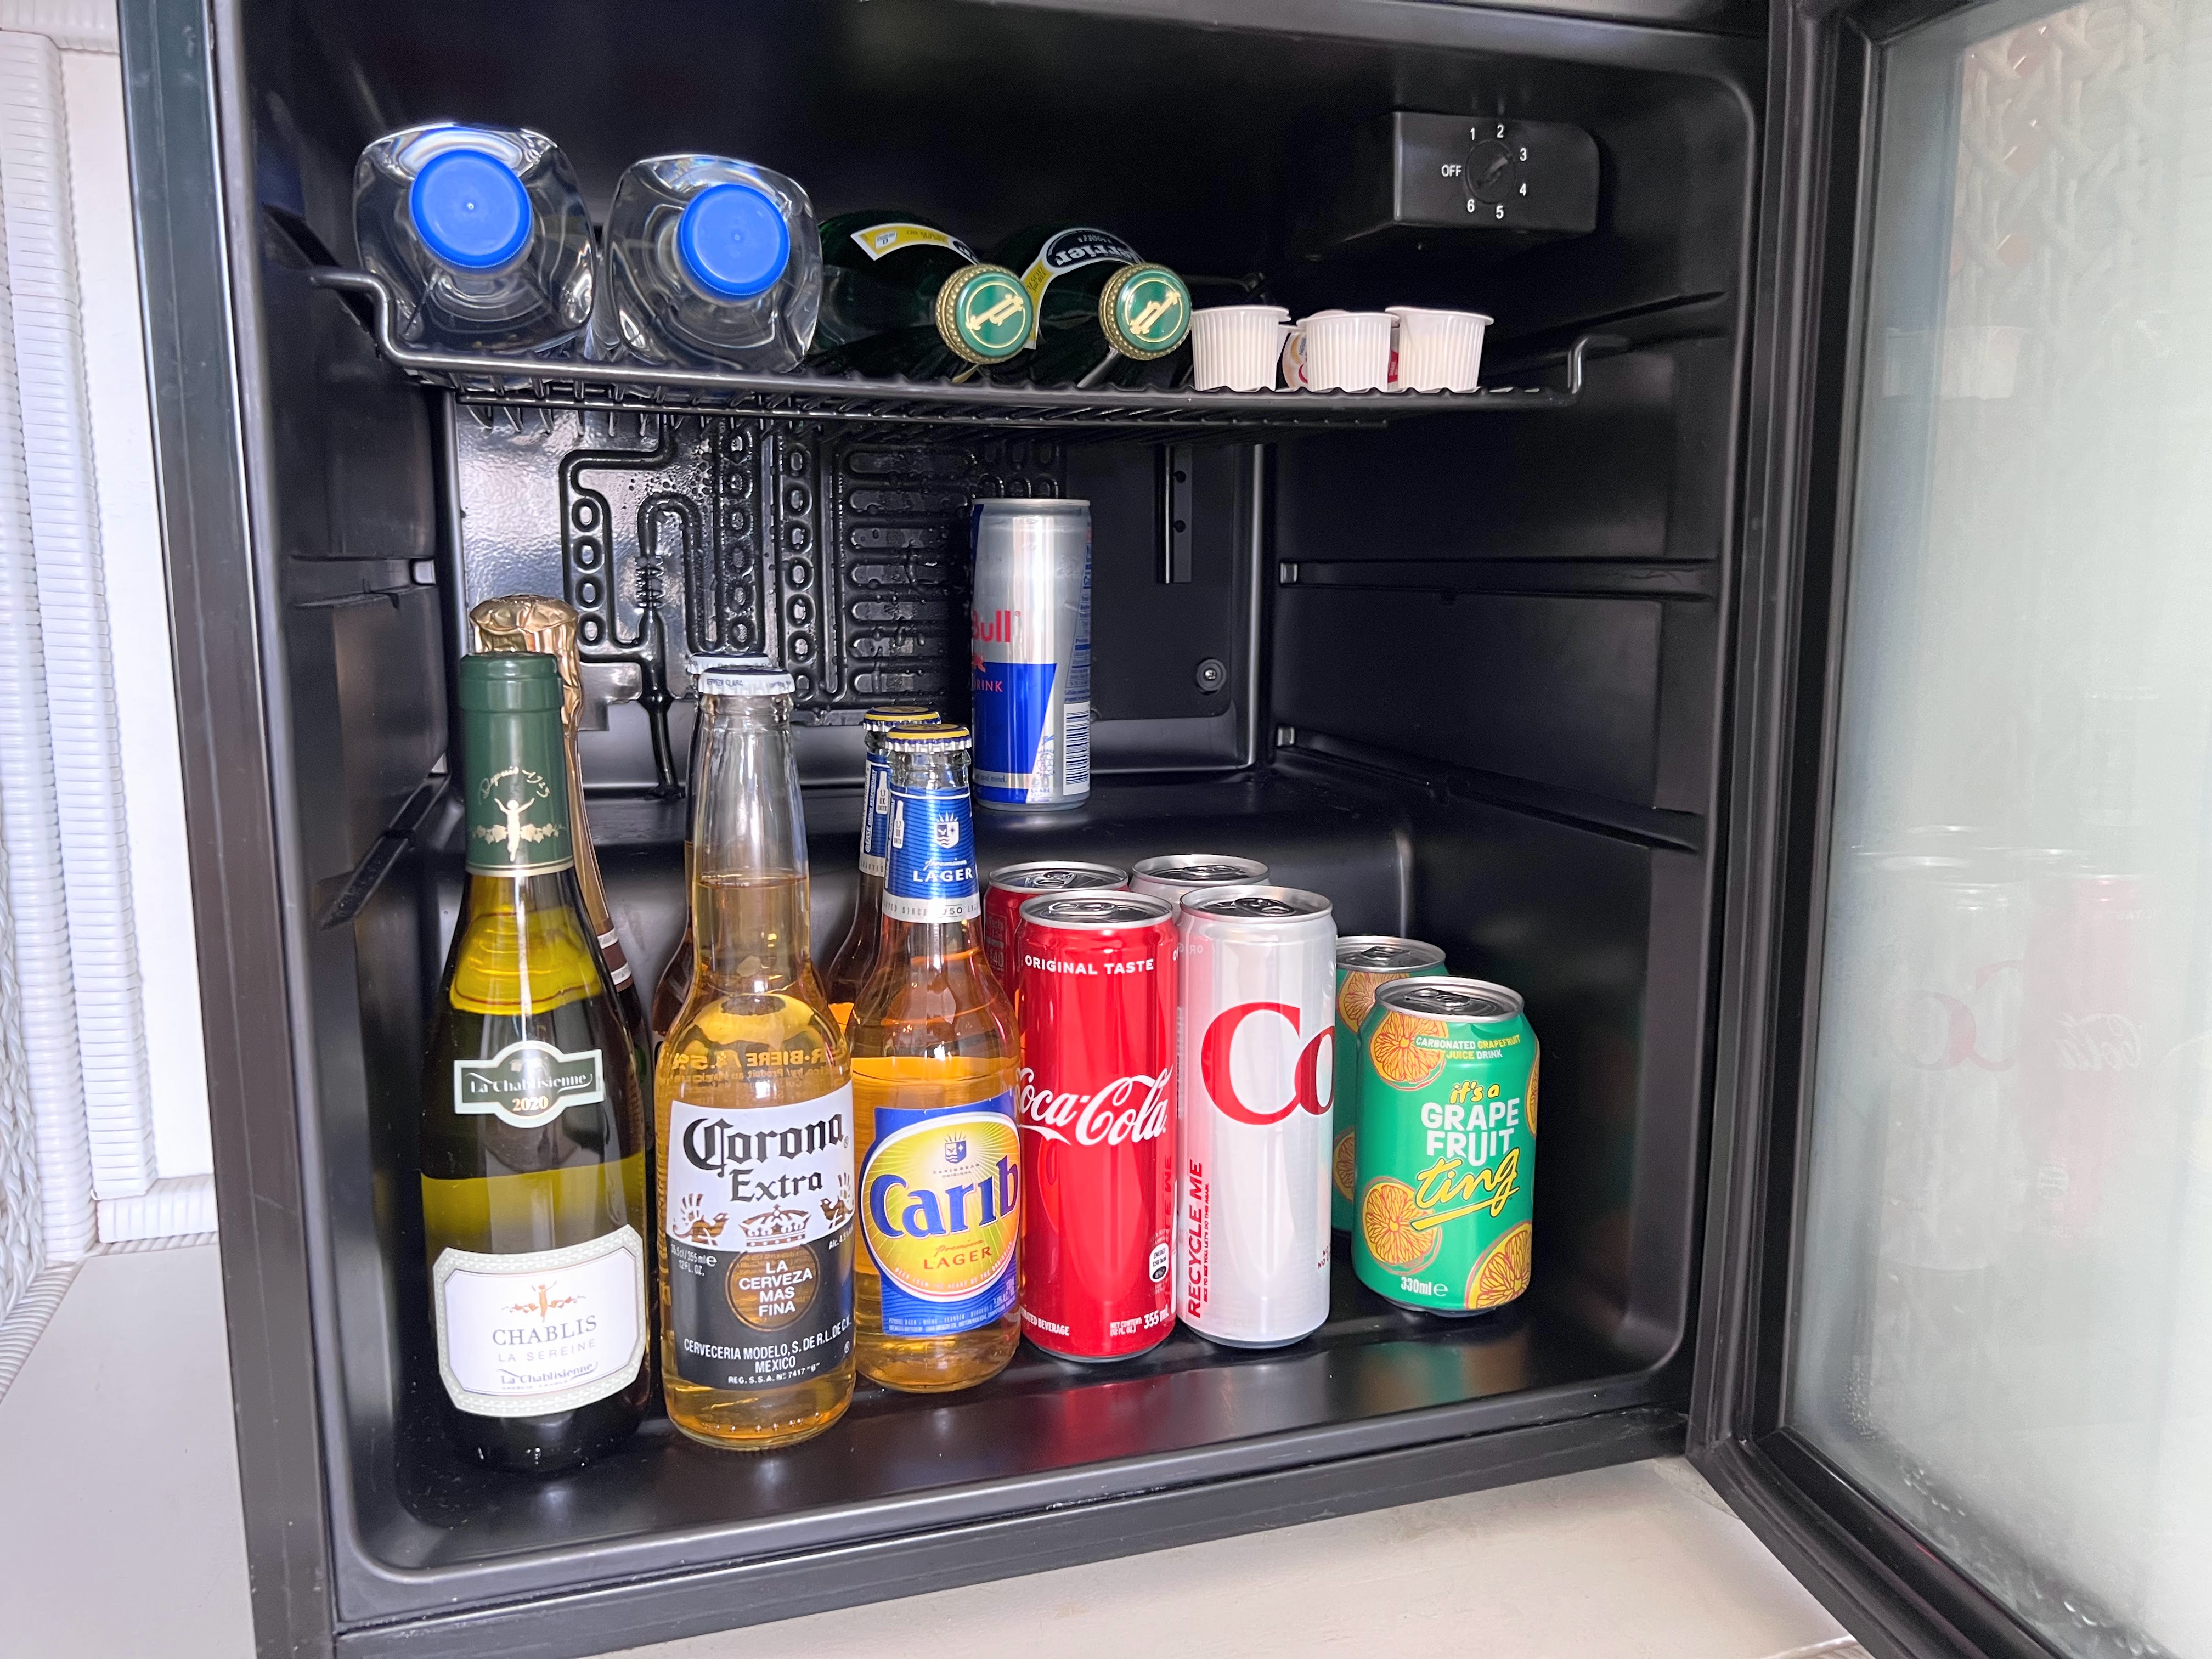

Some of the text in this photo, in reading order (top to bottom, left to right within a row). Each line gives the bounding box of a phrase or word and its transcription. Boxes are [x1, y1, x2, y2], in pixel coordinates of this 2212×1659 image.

[1470, 127, 1475, 140] 1
[1497, 124, 1504, 138] 2
[1520, 148, 1527, 161] 3
[1441, 165, 1462, 177] OFF
[1519, 183, 1526, 196] 4
[1467, 199, 1475, 213] 6
[1496, 205, 1504, 219] 5
[1055, 245, 1139, 266] errier
[974, 679, 1003, 693] RINK
[913, 867, 973, 883] LAGER
[902, 906, 927, 916] SINCE
[1025, 953, 1154, 975] ORIGINAL TASTE
[1415, 1034, 1521, 1050] CARBONATED GRAPEFRUIT
[1446, 1049, 1503, 1060] JUICE DRINK
[494, 1073, 587, 1093] Chablisienne
[1449, 1080, 1500, 1104] it's a
[512, 1096, 549, 1112] 2020
[1421, 1098, 1520, 1131] GRAPE
[683, 1114, 843, 1178] Corona
[1426, 1128, 1514, 1166] FRUIT
[729, 1168, 823, 1203] Extra
[1414, 1147, 1520, 1218] ting
[870, 1154, 1019, 1239] Carib
[1188, 1159, 1203, 1318] RECYCLE ME
[923, 1246, 992, 1270] LAGER
[933, 1239, 984, 1258] Premium
[766, 1260, 788, 1274] LA
[1318, 1257, 1325, 1270] NO
[738, 1268, 813, 1290] CERVEZA
[947, 1280, 967, 1289] HEART
[980, 1269, 991, 1280] THE
[1401, 1276, 1432, 1296] 330ml
[759, 1286, 795, 1304] MAS
[758, 1302, 796, 1317] FINA
[1037, 1318, 1070, 1336] BEVERAGE
[1144, 1310, 1159, 1330] 355
[492, 1314, 597, 1346] CHABLIS
[498, 1338, 596, 1362] LA SEREINE
[684, 1338, 741, 1360] CERVECERIA
[743, 1343, 791, 1360] MODELO,
[791, 1340, 802, 1355] S.
[803, 1336, 815, 1351] DE
[816, 1330, 832, 1346] R.L.
[832, 1322, 842, 1339] DE
[501, 1375, 516, 1385] La
[520, 1363, 593, 1384] Chablisienne
[755, 1355, 796, 1374] MEXICO
[727, 1375, 747, 1384] REG.
[749, 1374, 775, 1384] S.S.A.
[788, 1367, 806, 1379] 7417
